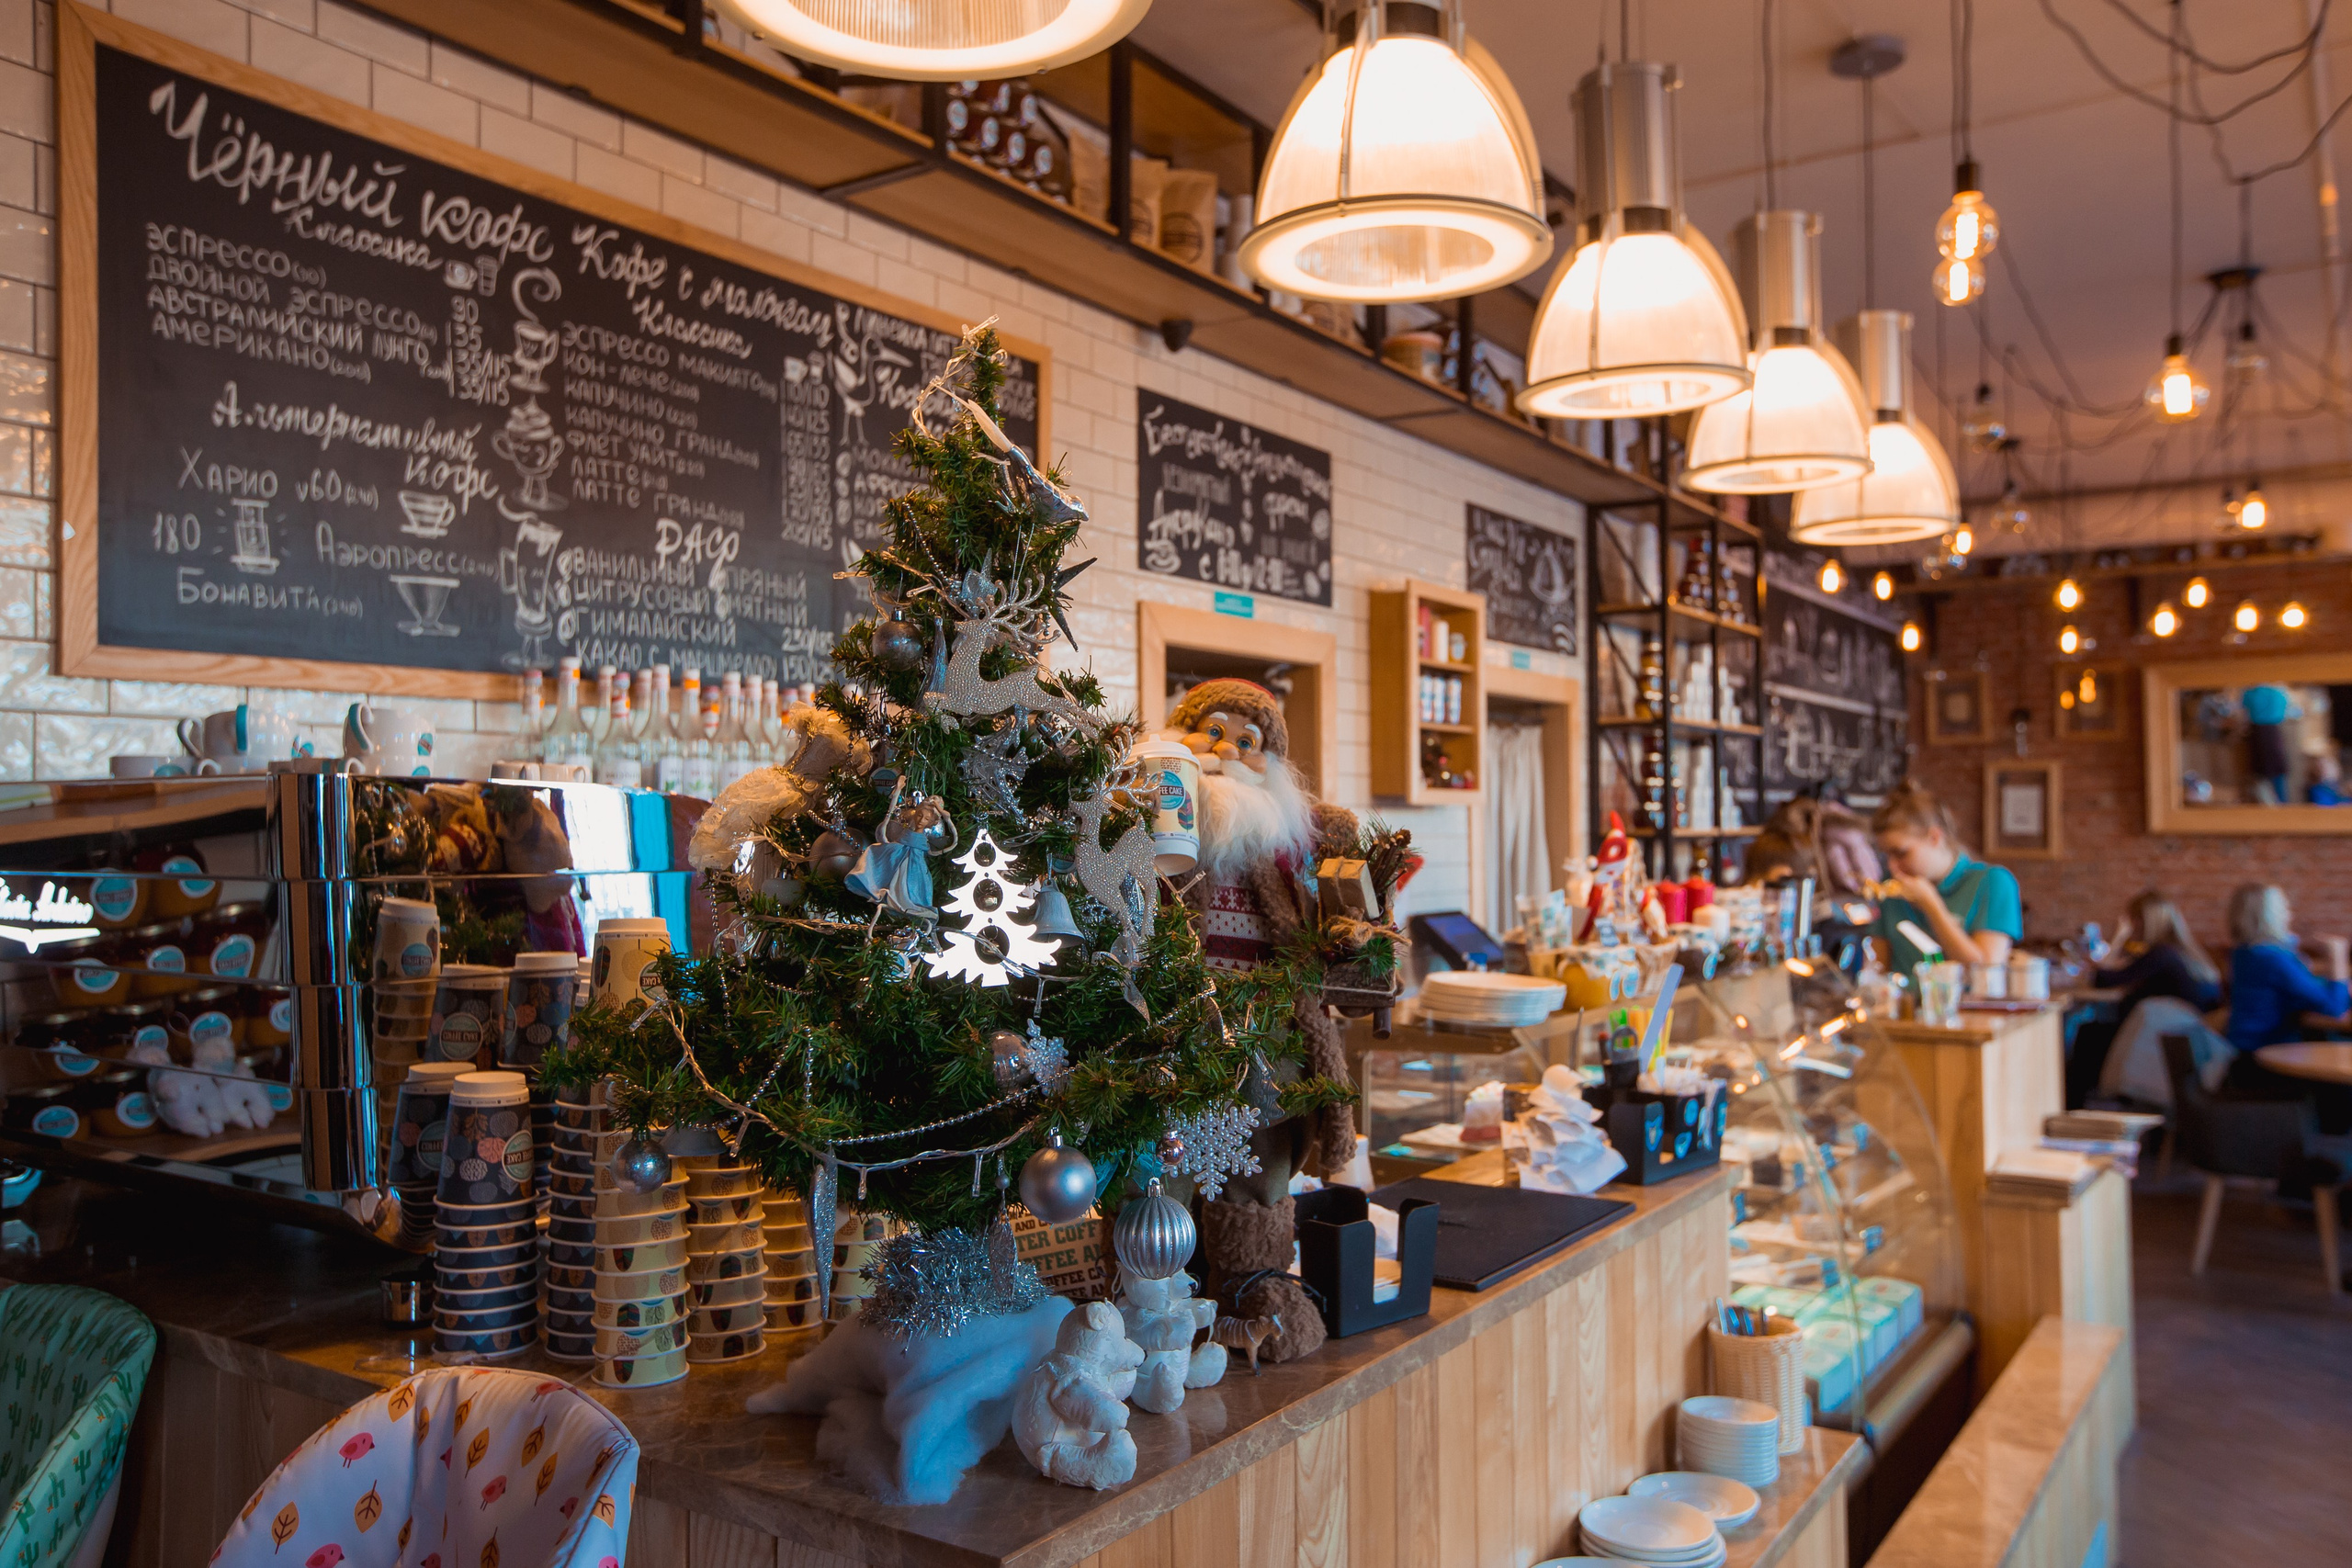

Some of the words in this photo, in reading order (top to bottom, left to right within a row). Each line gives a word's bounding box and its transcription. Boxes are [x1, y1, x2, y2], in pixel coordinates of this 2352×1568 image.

[152, 82, 403, 227] Чёрный
[148, 254, 270, 304] ДВОЙНОЙ
[149, 285, 363, 354] АВСТРАЛИЙСКИЙ
[373, 332, 429, 365] ЛУНГО
[452, 297, 479, 325] 90
[565, 377, 664, 419] КАПУЧИНО
[214, 382, 481, 460] Альтернативный
[566, 404, 664, 446] КАПУЧИНО
[153, 513, 201, 553] 180
[574, 547, 695, 587] ВАНИЛЬНЫЙ
[726, 567, 807, 600] ПРЯНЫЙ
[575, 578, 710, 615] ЦИТРУСОВЫЙ
[576, 637, 642, 671] КАКАО
[1169, 786, 1182, 795] CAKE
[1014, 1219, 1035, 1233] AND
[1054, 1218, 1102, 1245] COFF
